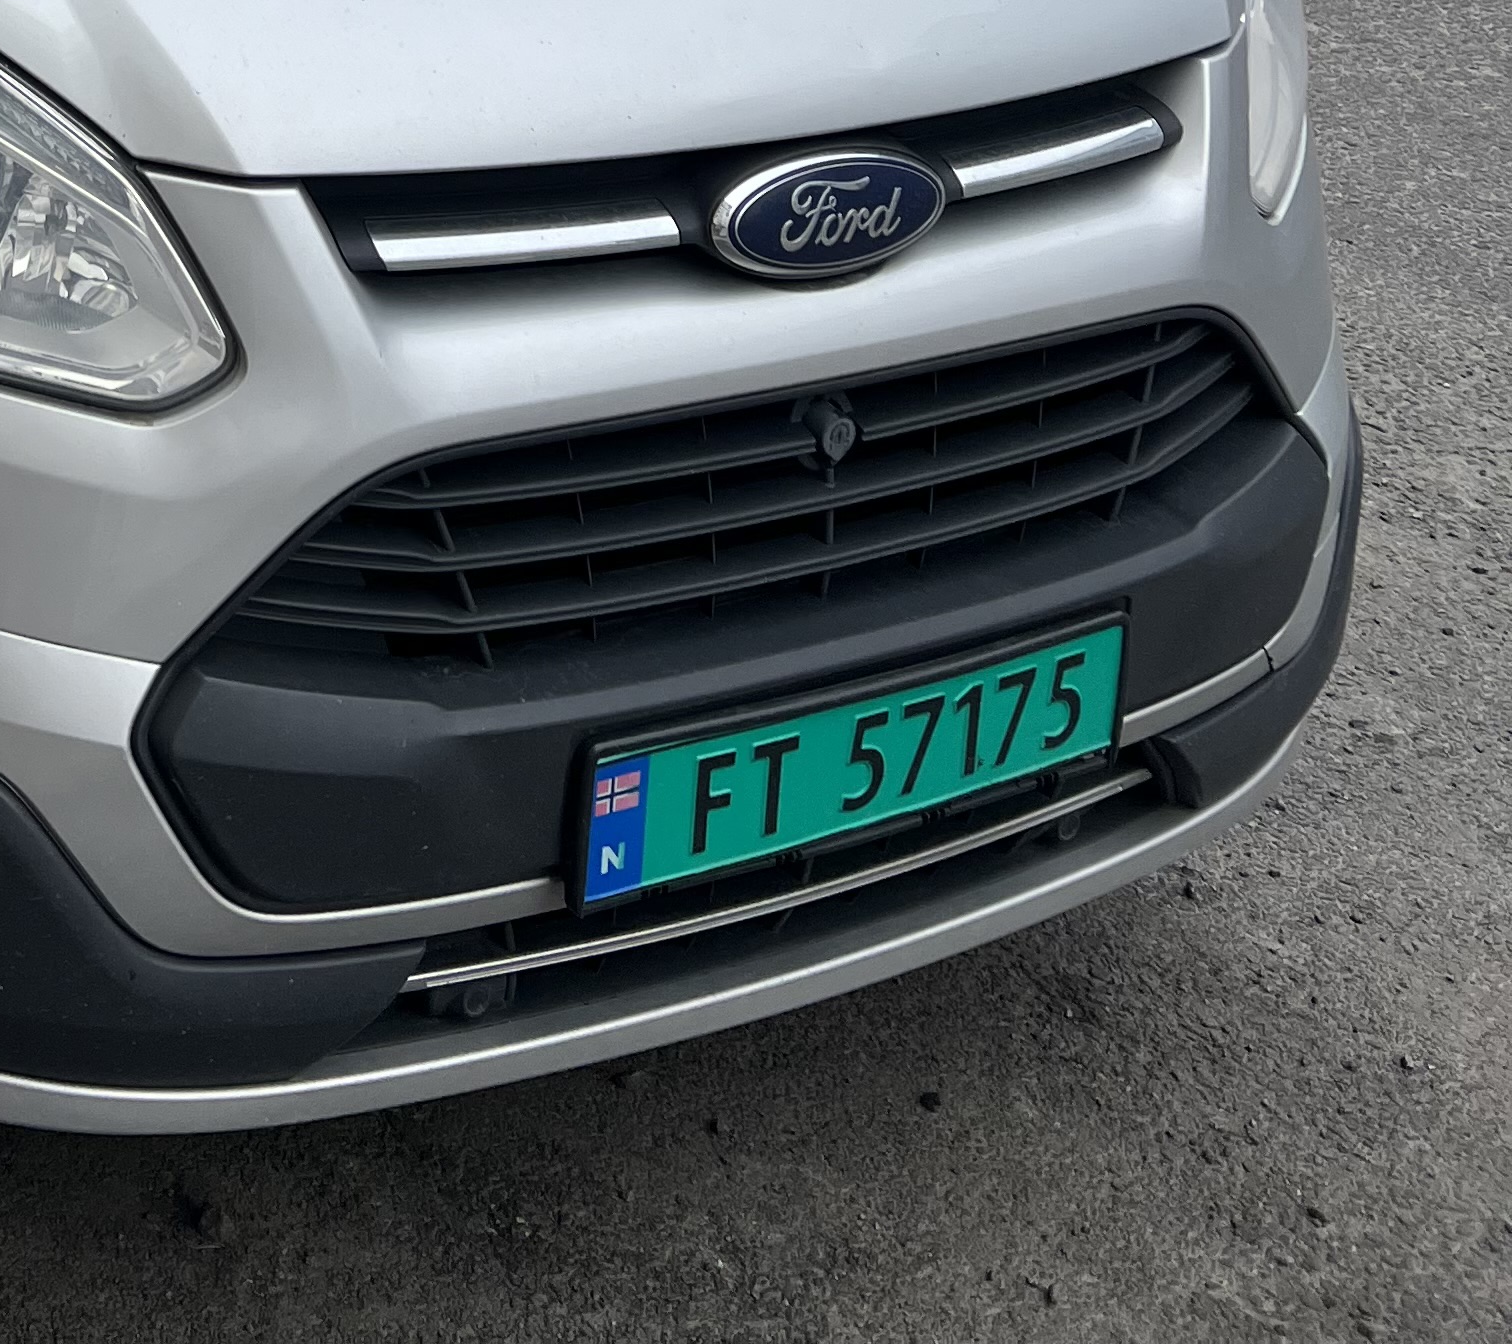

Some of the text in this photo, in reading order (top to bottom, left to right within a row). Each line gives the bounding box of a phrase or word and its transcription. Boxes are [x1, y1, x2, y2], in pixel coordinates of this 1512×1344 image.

[779, 175, 903, 253] Ford
[691, 648, 1088, 855] FT 57175
[599, 842, 626, 875] N
